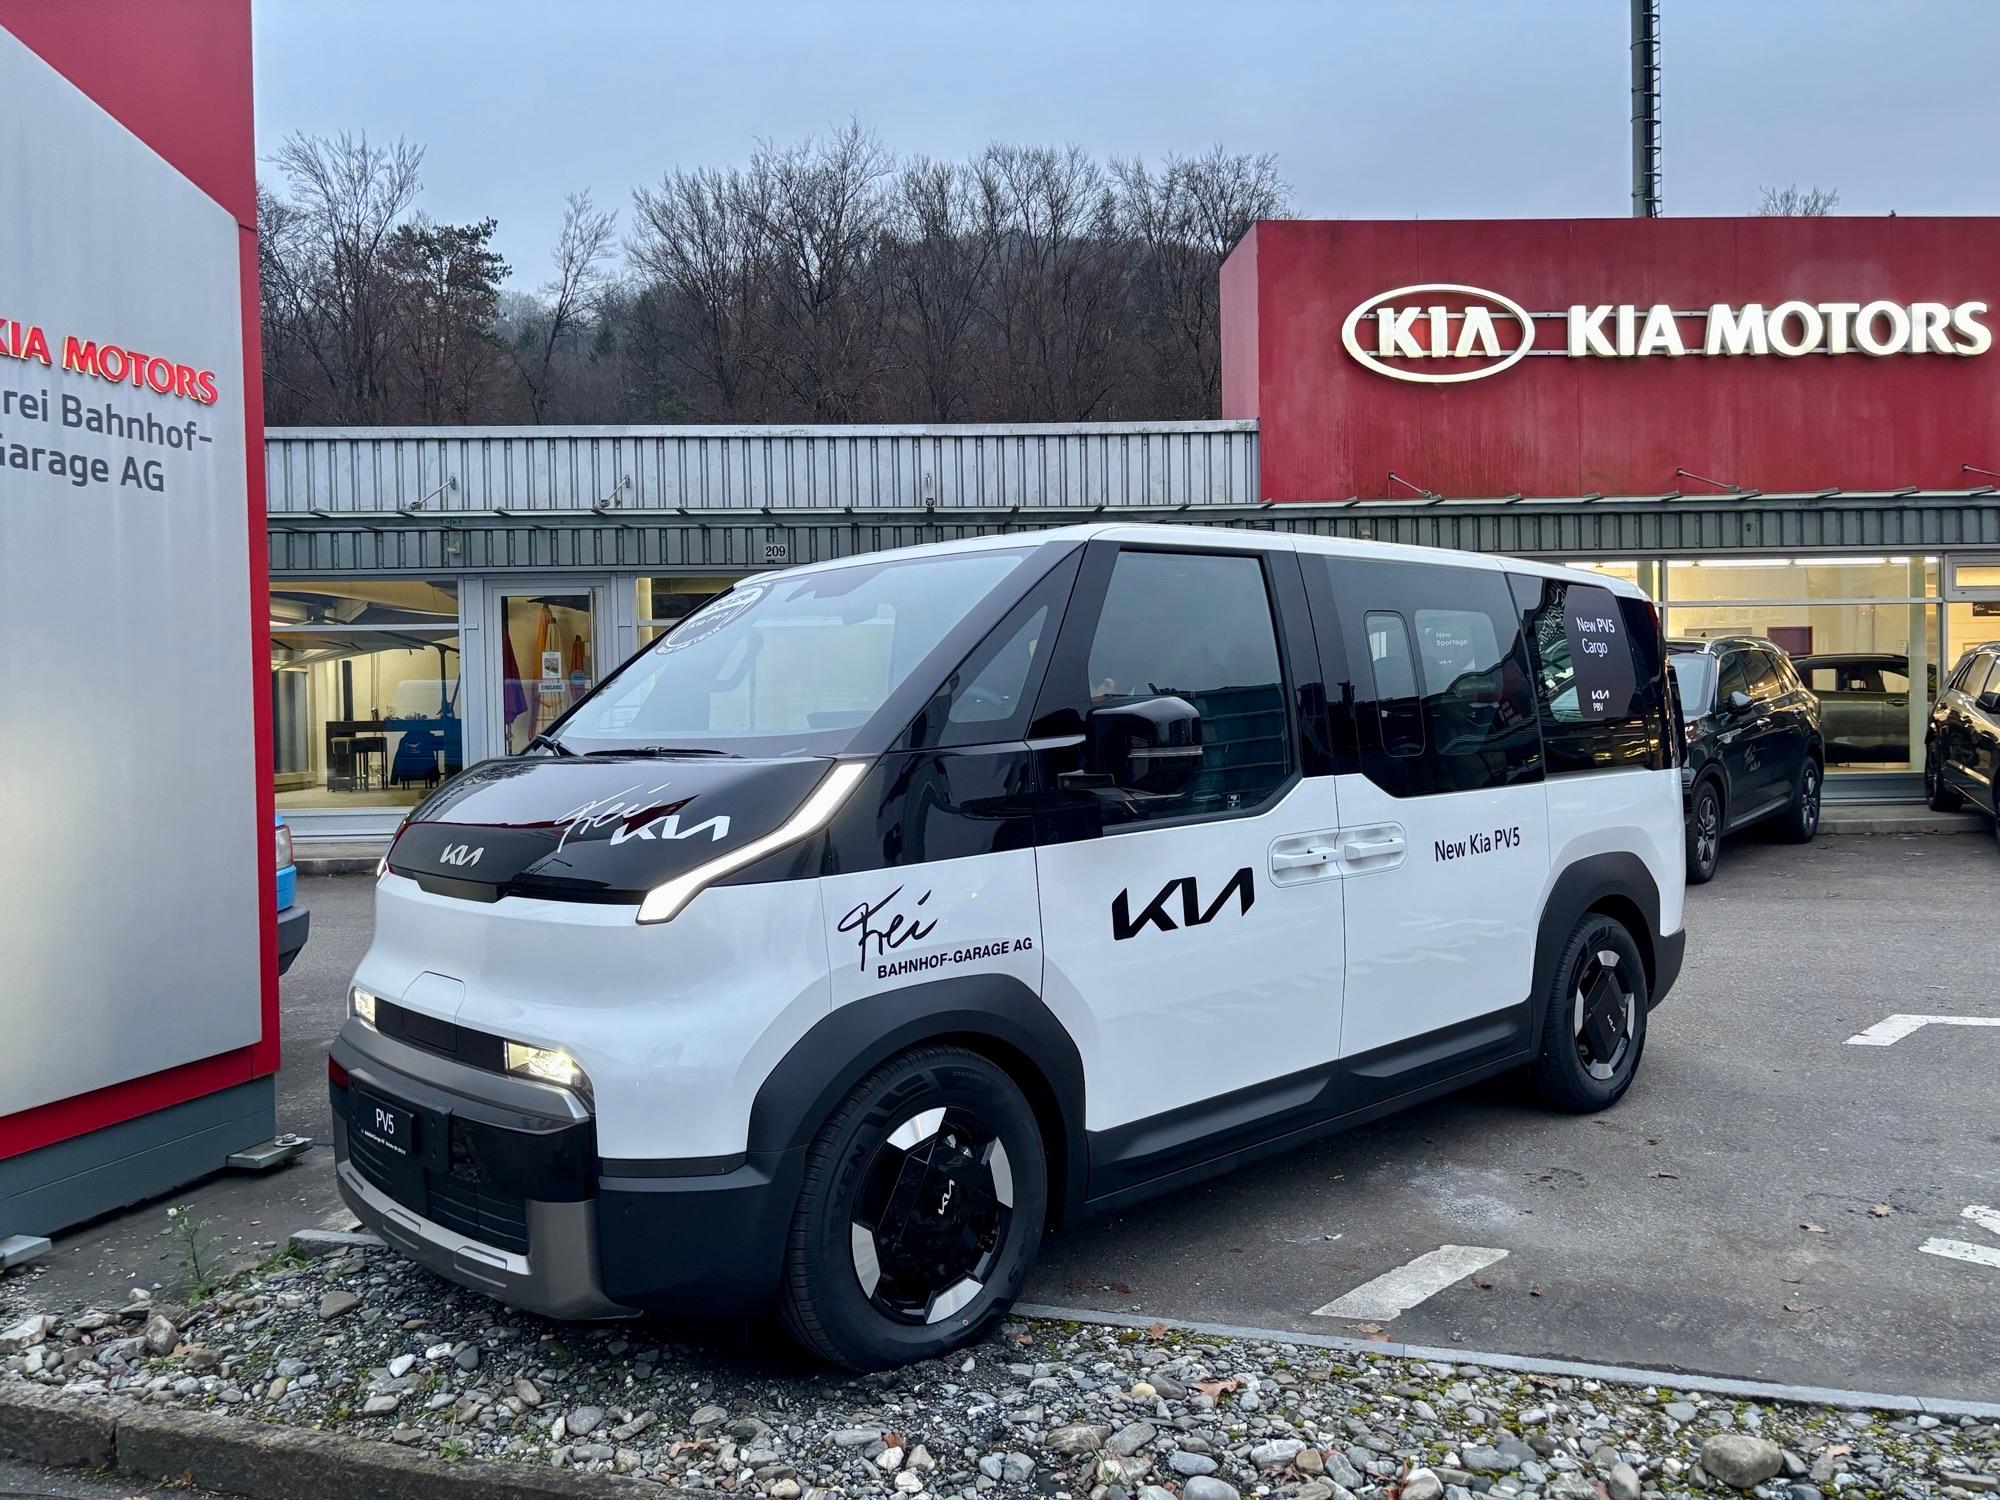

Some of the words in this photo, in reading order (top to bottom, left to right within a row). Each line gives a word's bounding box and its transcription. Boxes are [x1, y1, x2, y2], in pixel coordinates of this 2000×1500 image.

[1376, 306, 1502, 359] KIA
[1567, 304, 1686, 359] KIA
[1703, 300, 1993, 359] MOTORS
[61, 335, 219, 405] MOTORS
[61, 393, 213, 451] Bahnhof-
[119, 455, 165, 492] AG
[765, 545, 786, 557] 209
[1576, 617, 1597, 632] New
[1596, 618, 1615, 633] PV5
[1581, 638, 1608, 657] Cargo
[1591, 689, 1609, 700] KIA
[610, 814, 731, 846] KIA
[1434, 839, 1467, 863] New
[1469, 832, 1491, 855] Kia
[1494, 826, 1521, 850] PV5
[440, 842, 485, 867] KIA
[1111, 866, 1256, 941] KIA
[877, 940, 1010, 980] BAHNHOF-GARAGE
[1013, 936, 1033, 953] AG
[375, 1107, 395, 1135] PV5
